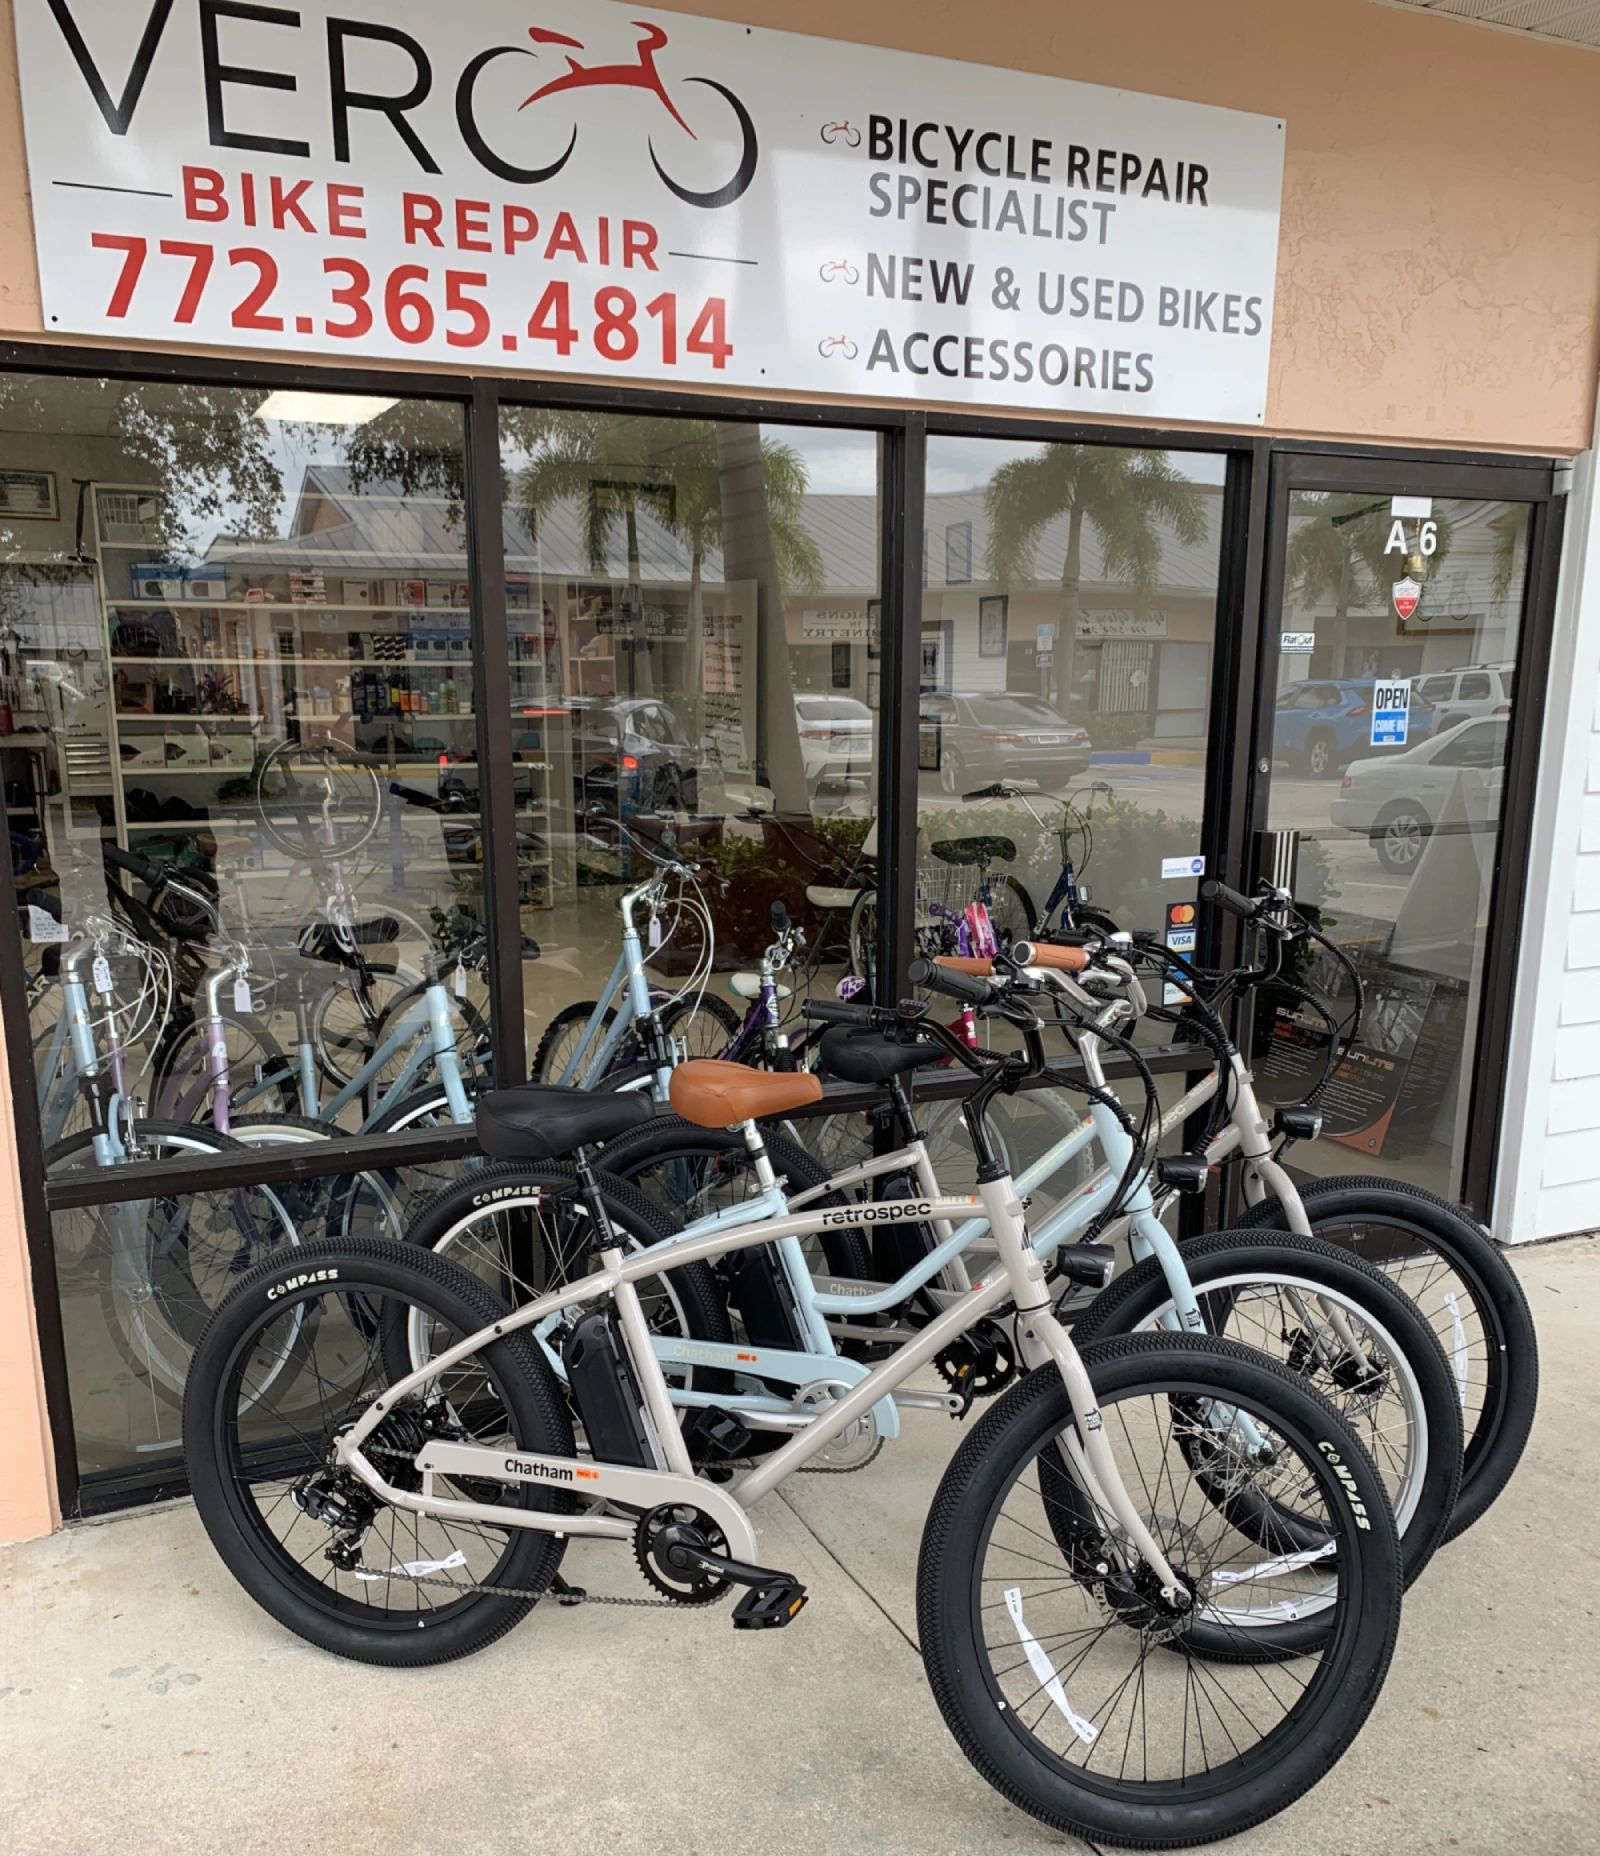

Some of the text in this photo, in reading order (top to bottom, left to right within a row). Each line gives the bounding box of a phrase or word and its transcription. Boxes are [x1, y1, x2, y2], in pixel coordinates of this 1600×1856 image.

[868, 114, 1209, 207] BICYCLE REPAIR
[181, 165, 661, 272] BIKE REPAIR
[868, 171, 1117, 245] SPECIALIST
[91, 232, 733, 370] 772.365.4814
[866, 252, 1263, 336] NEW & USED BIKES
[866, 328, 1154, 393] ACCESSORIES
[1384, 520, 1438, 556] A 6
[1376, 687, 1409, 709] OPEN
[1172, 935, 1192, 945] VISA
[473, 1185, 541, 1206] COMPASS
[822, 1202, 932, 1226] retrospec
[267, 1268, 338, 1300] COMPASS
[829, 1283, 874, 1297] Chatha
[504, 1458, 574, 1482] Chatham
[1317, 1441, 1372, 1532] COMPASS
